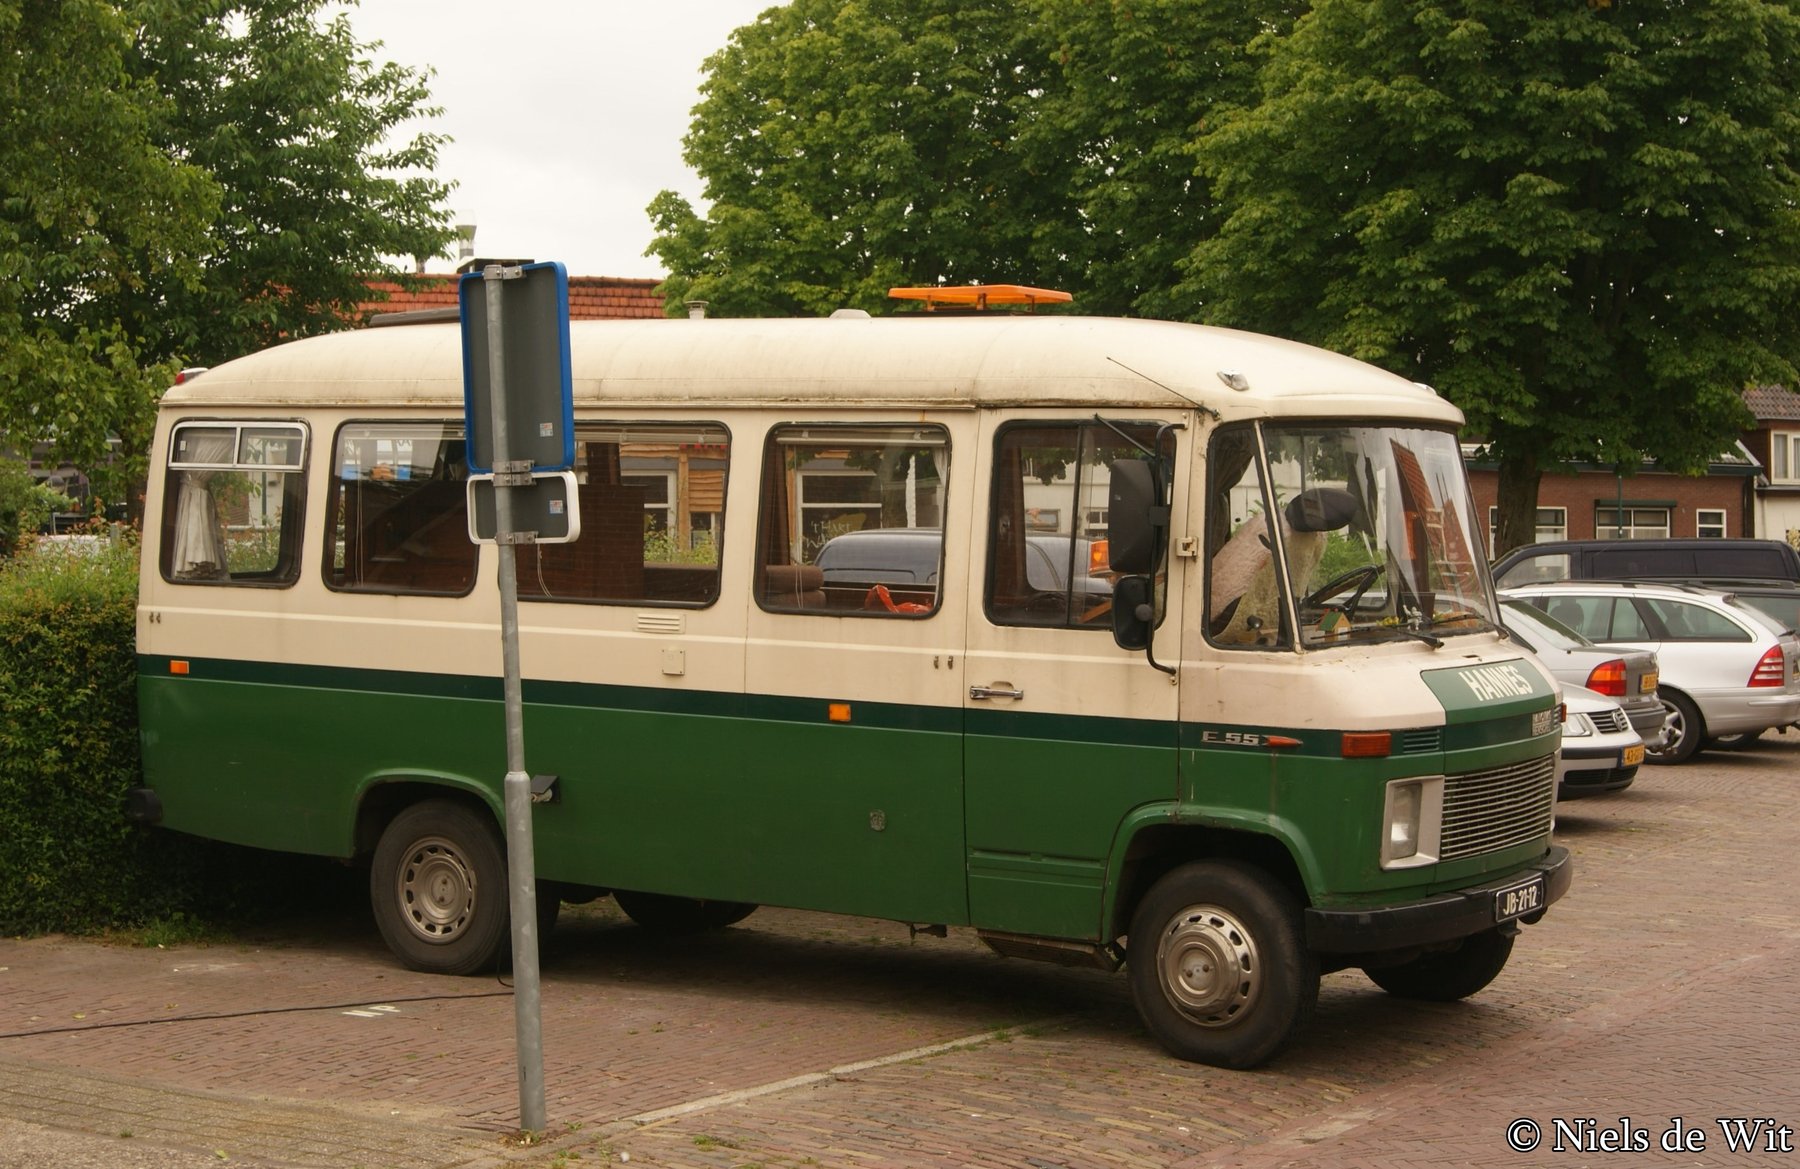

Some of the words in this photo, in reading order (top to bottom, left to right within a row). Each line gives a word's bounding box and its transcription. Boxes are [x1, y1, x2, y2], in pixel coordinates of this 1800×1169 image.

[1458, 664, 1534, 702] HANNES
[1225, 732, 1260, 746] 55
[1502, 885, 1538, 916] JB-21-12
